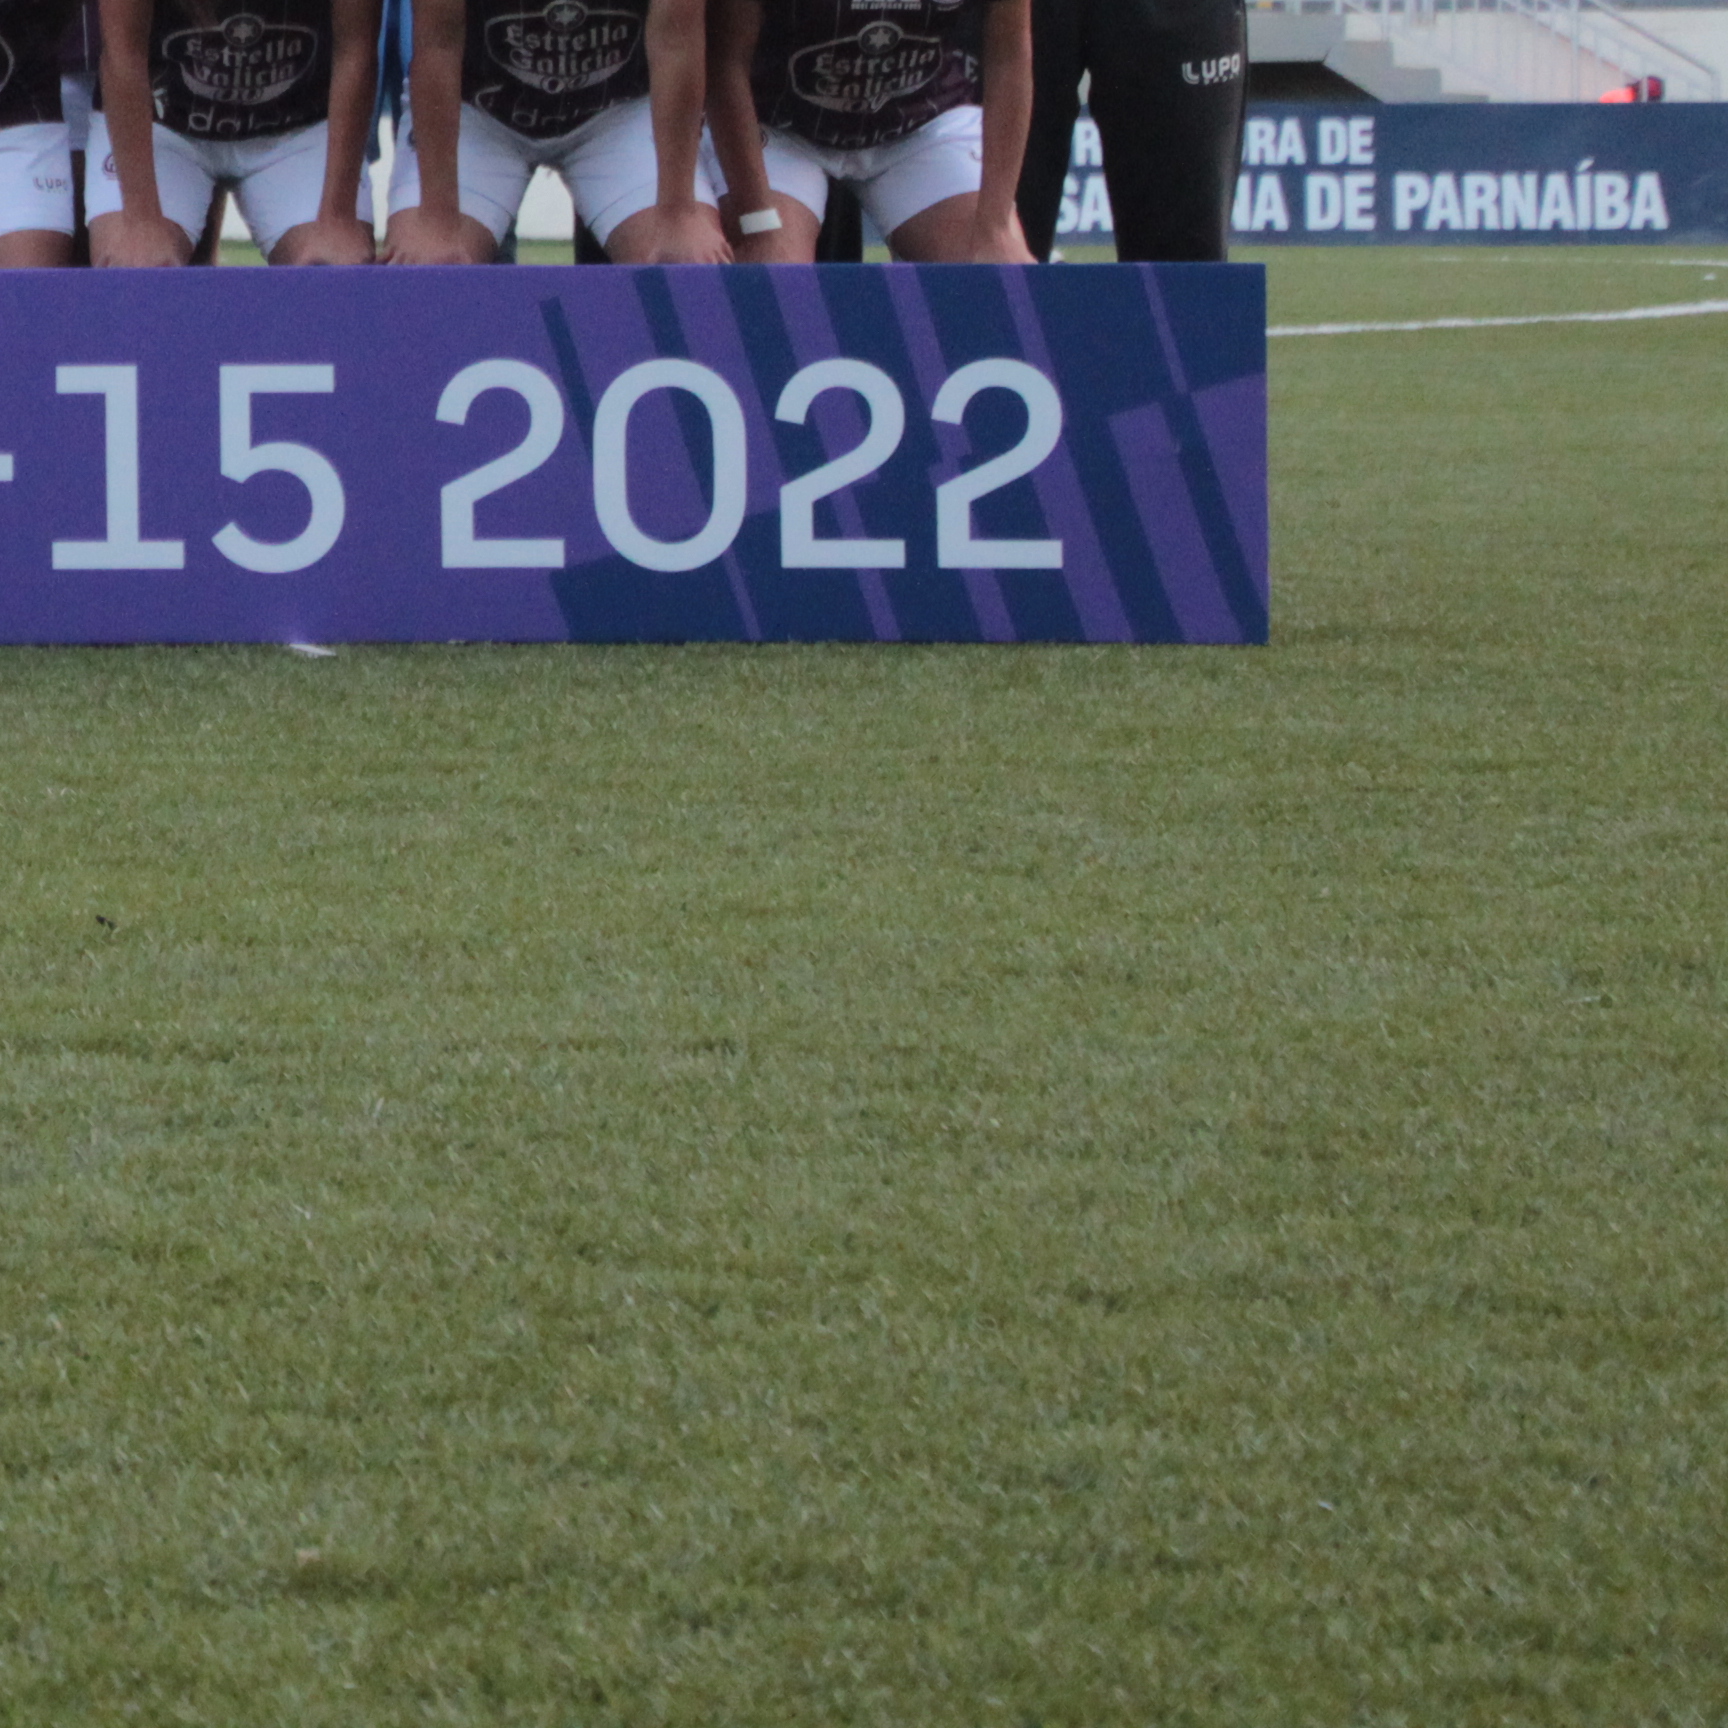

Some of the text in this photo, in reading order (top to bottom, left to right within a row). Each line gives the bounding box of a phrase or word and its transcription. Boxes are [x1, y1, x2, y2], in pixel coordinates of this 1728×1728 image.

[505, 20, 628, 50] Estrella
[1319, 116, 1375, 166] DE
[1305, 174, 1377, 232] DE
[1392, 156, 1668, 232] PARNAÍBA
[434, 357, 1065, 573] 2022
